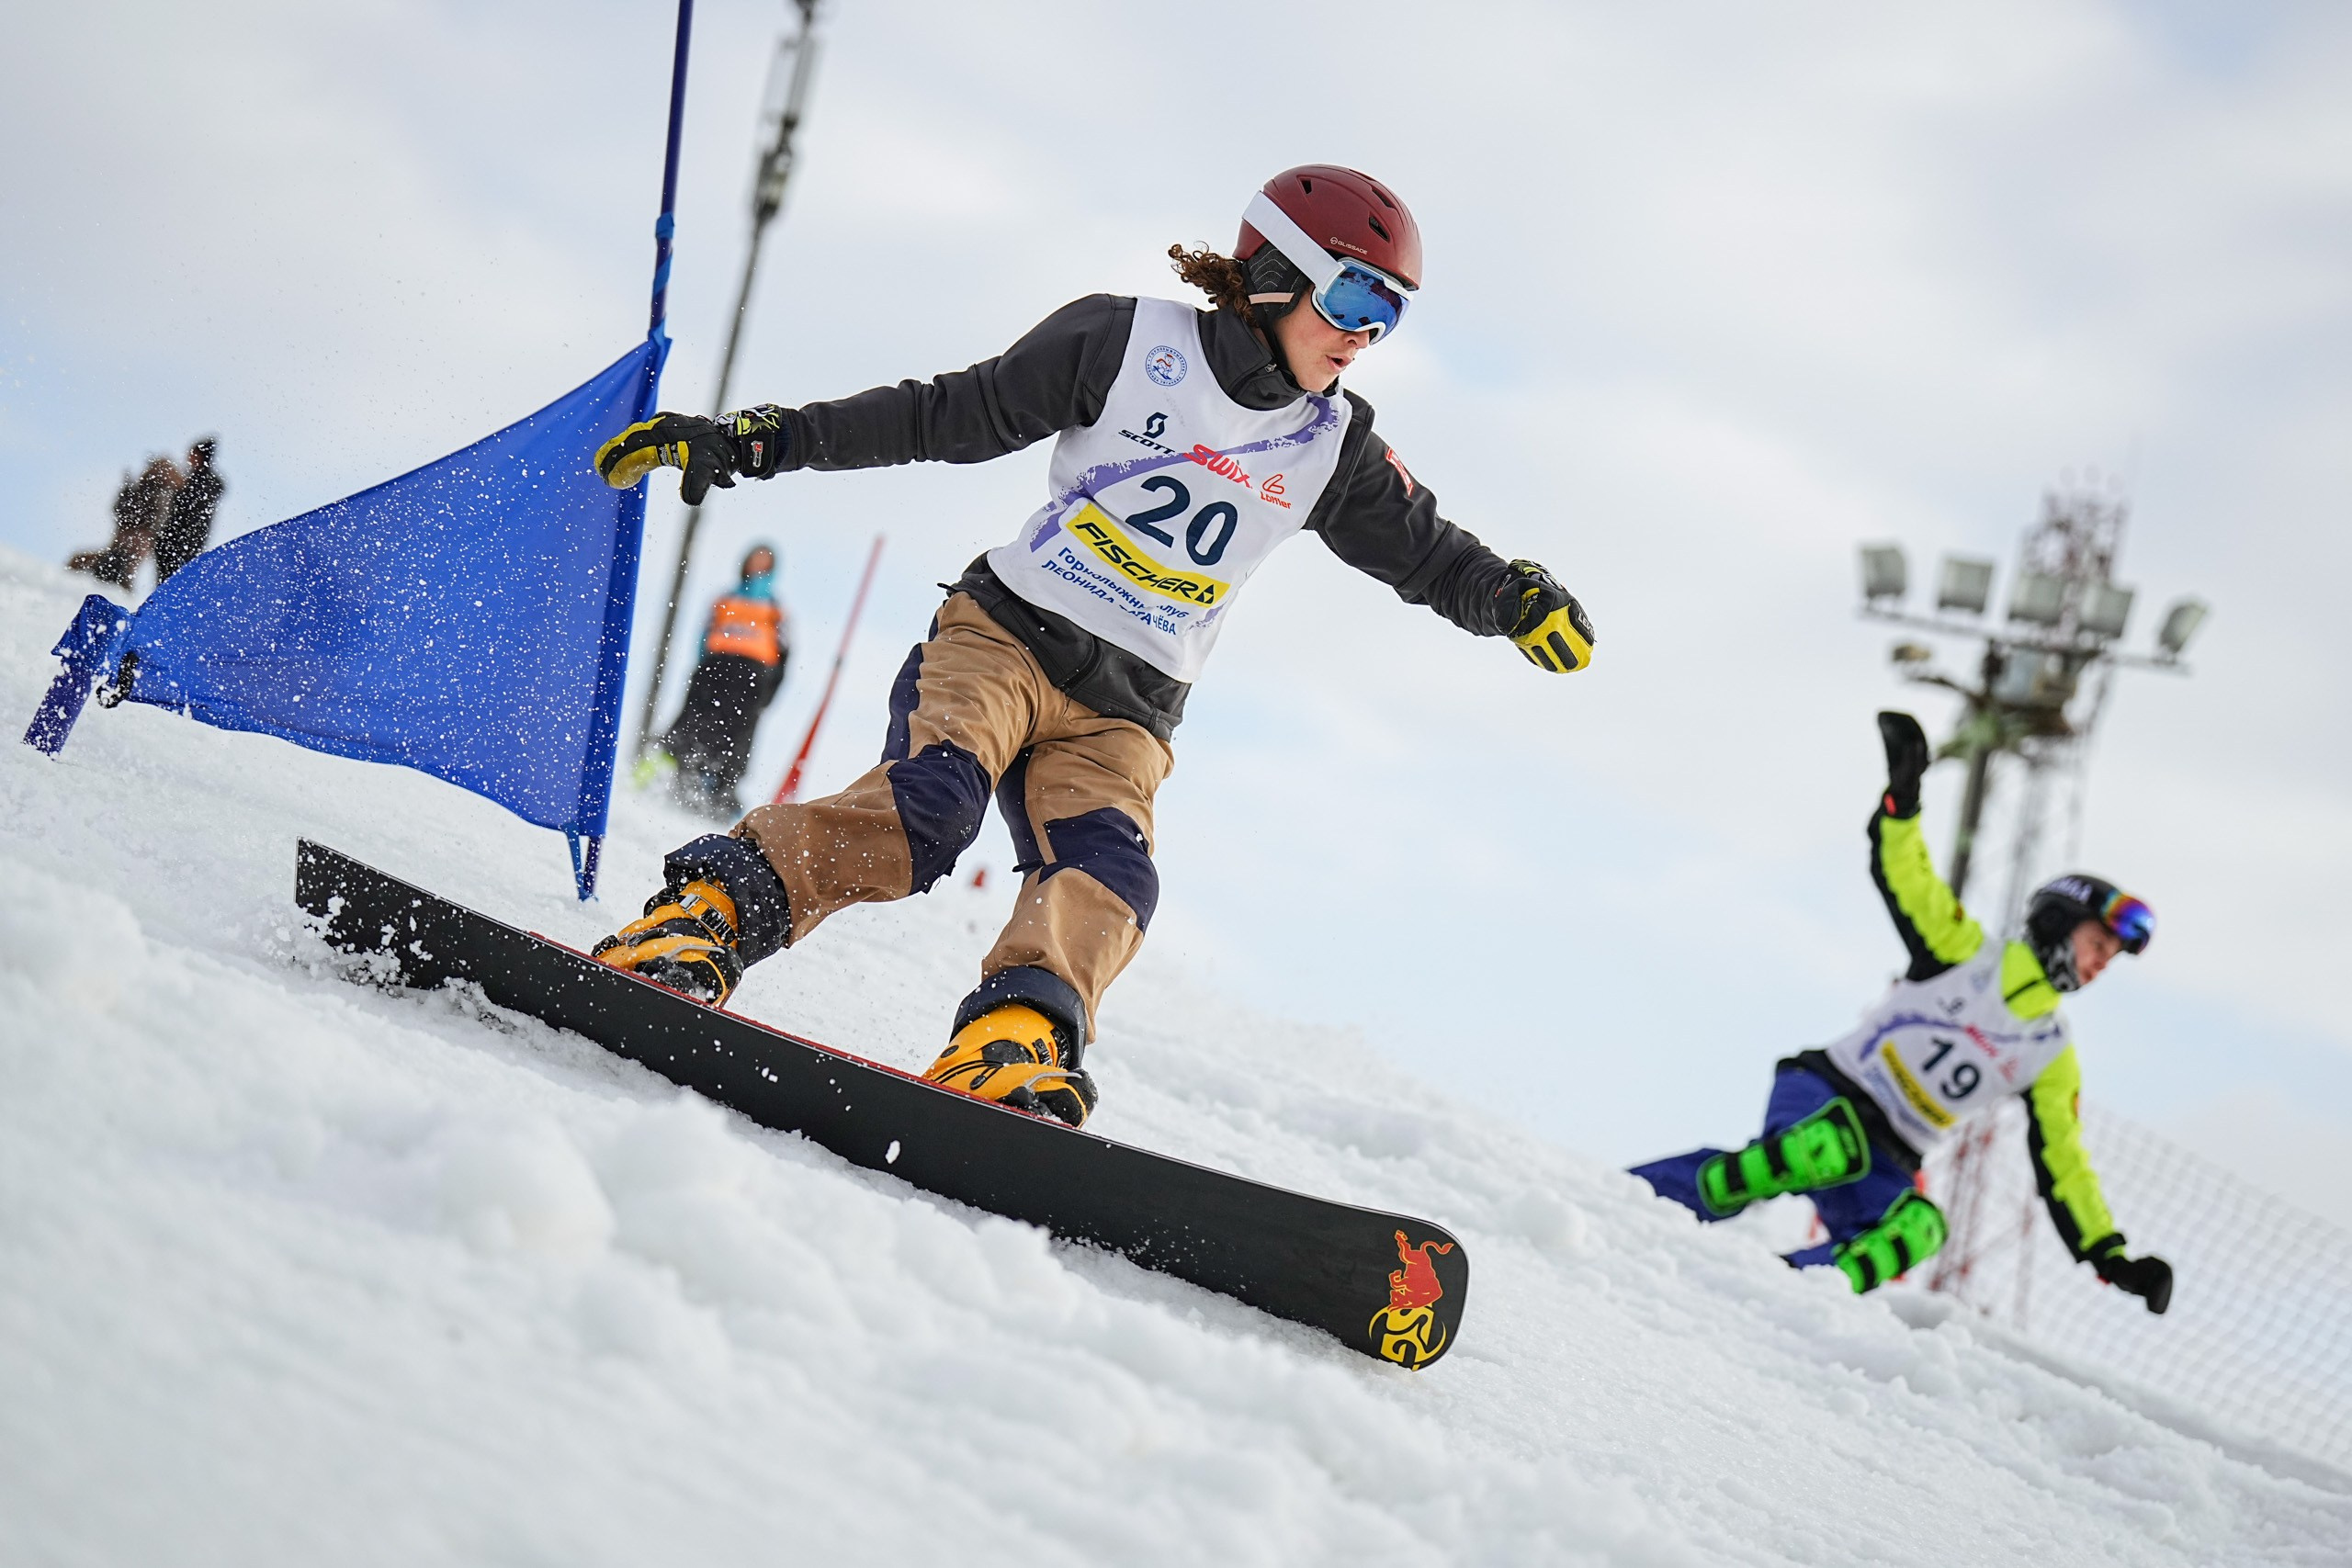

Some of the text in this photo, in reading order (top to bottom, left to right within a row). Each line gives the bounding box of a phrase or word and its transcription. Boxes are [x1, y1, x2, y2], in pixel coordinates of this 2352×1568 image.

[1118, 429, 1175, 455] SCOTT
[1125, 475, 1238, 566] 20
[1075, 522, 1200, 599] FISCHER
[1157, 604, 1190, 618] луб
[1922, 1035, 1980, 1100] 19
